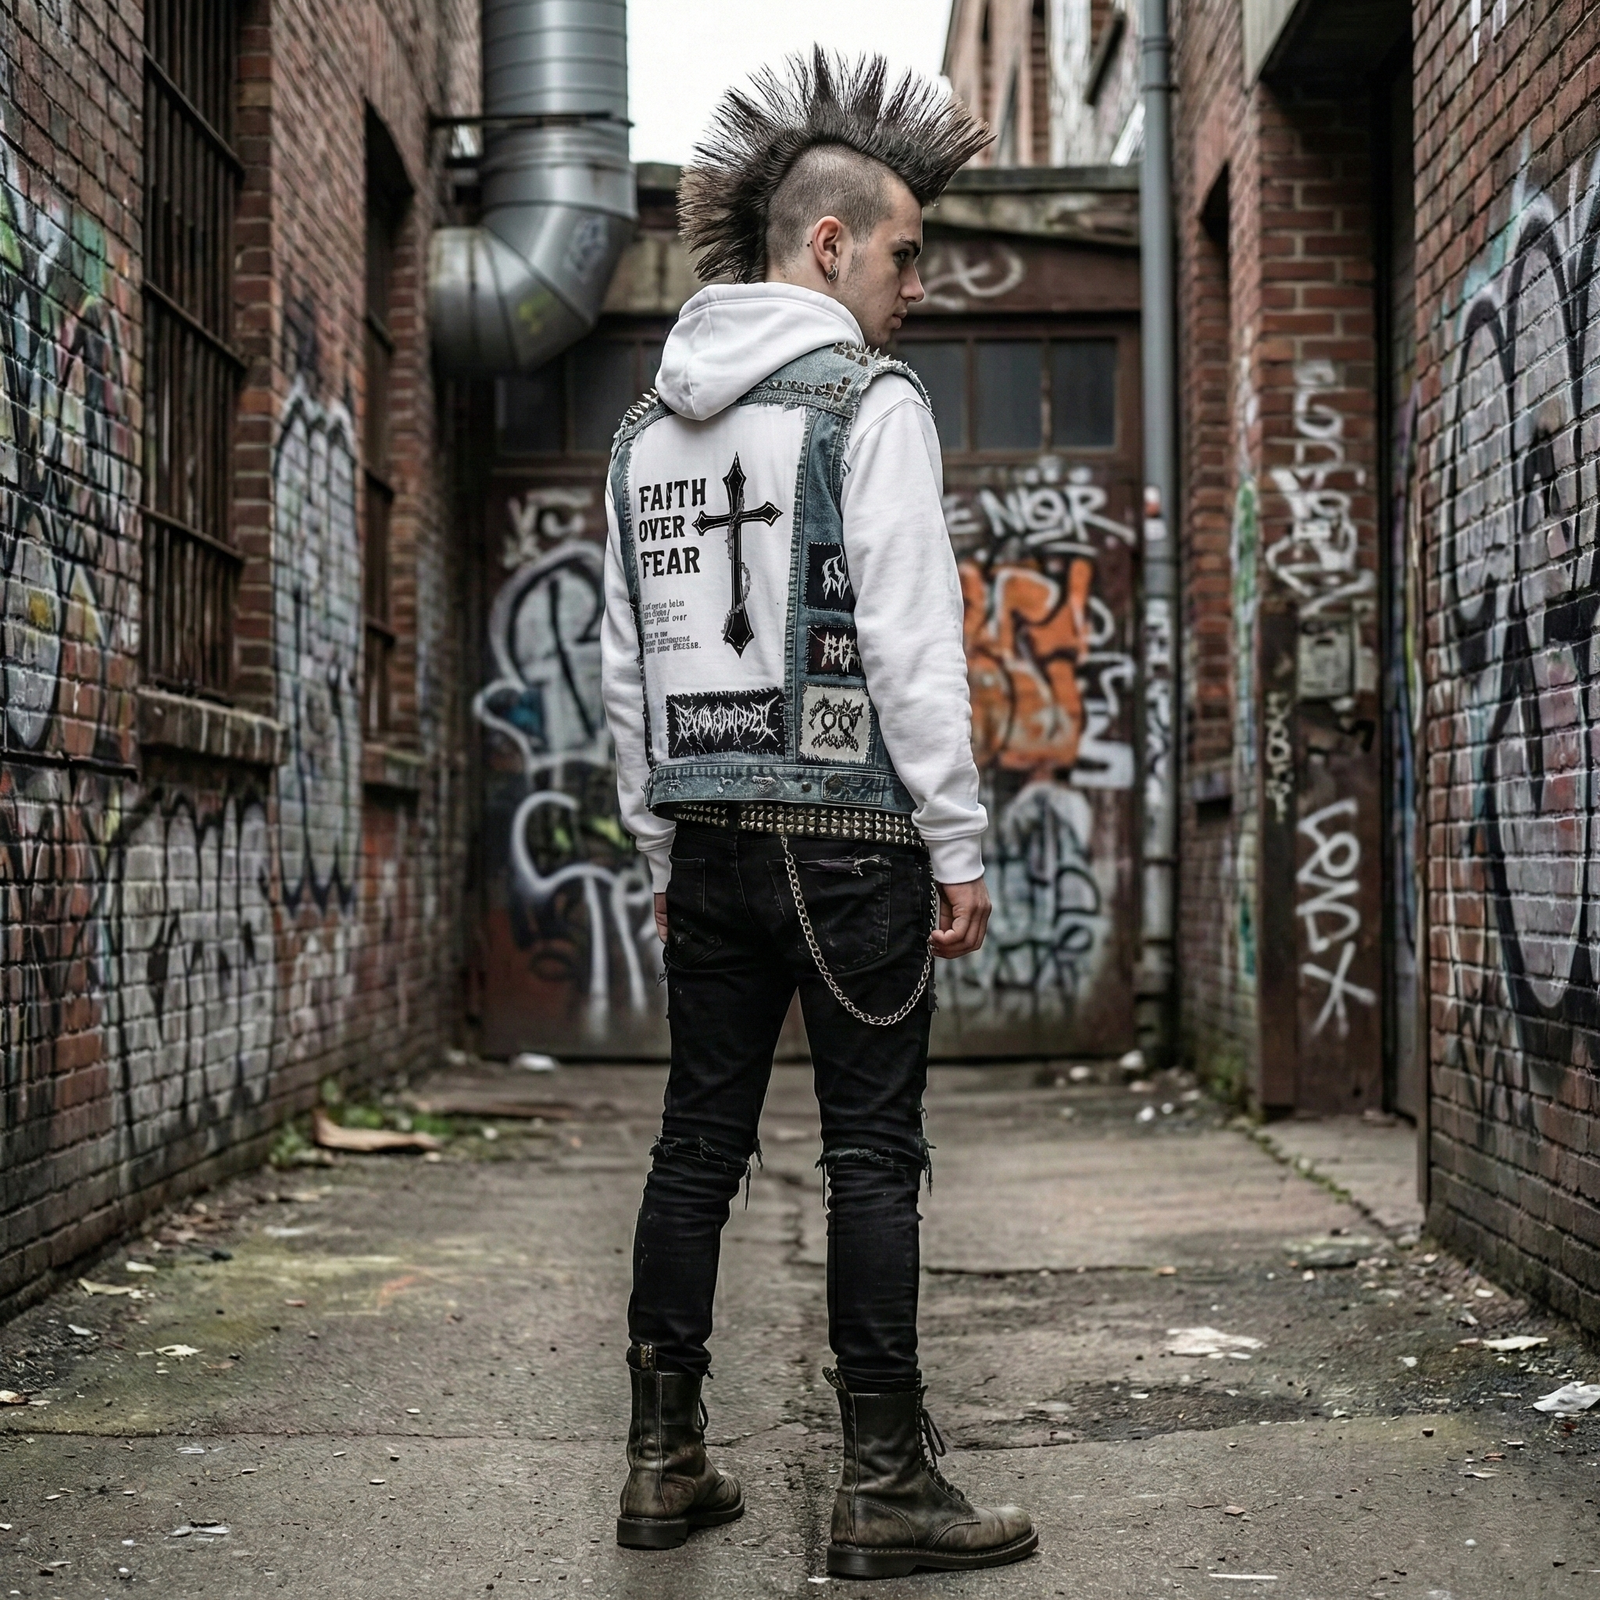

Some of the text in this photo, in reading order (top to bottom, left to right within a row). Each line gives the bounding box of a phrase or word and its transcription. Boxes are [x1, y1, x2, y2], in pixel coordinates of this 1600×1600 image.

[639, 478, 706, 513] FAITH
[639, 515, 685, 542] OVER
[640, 546, 700, 579] FEAR
